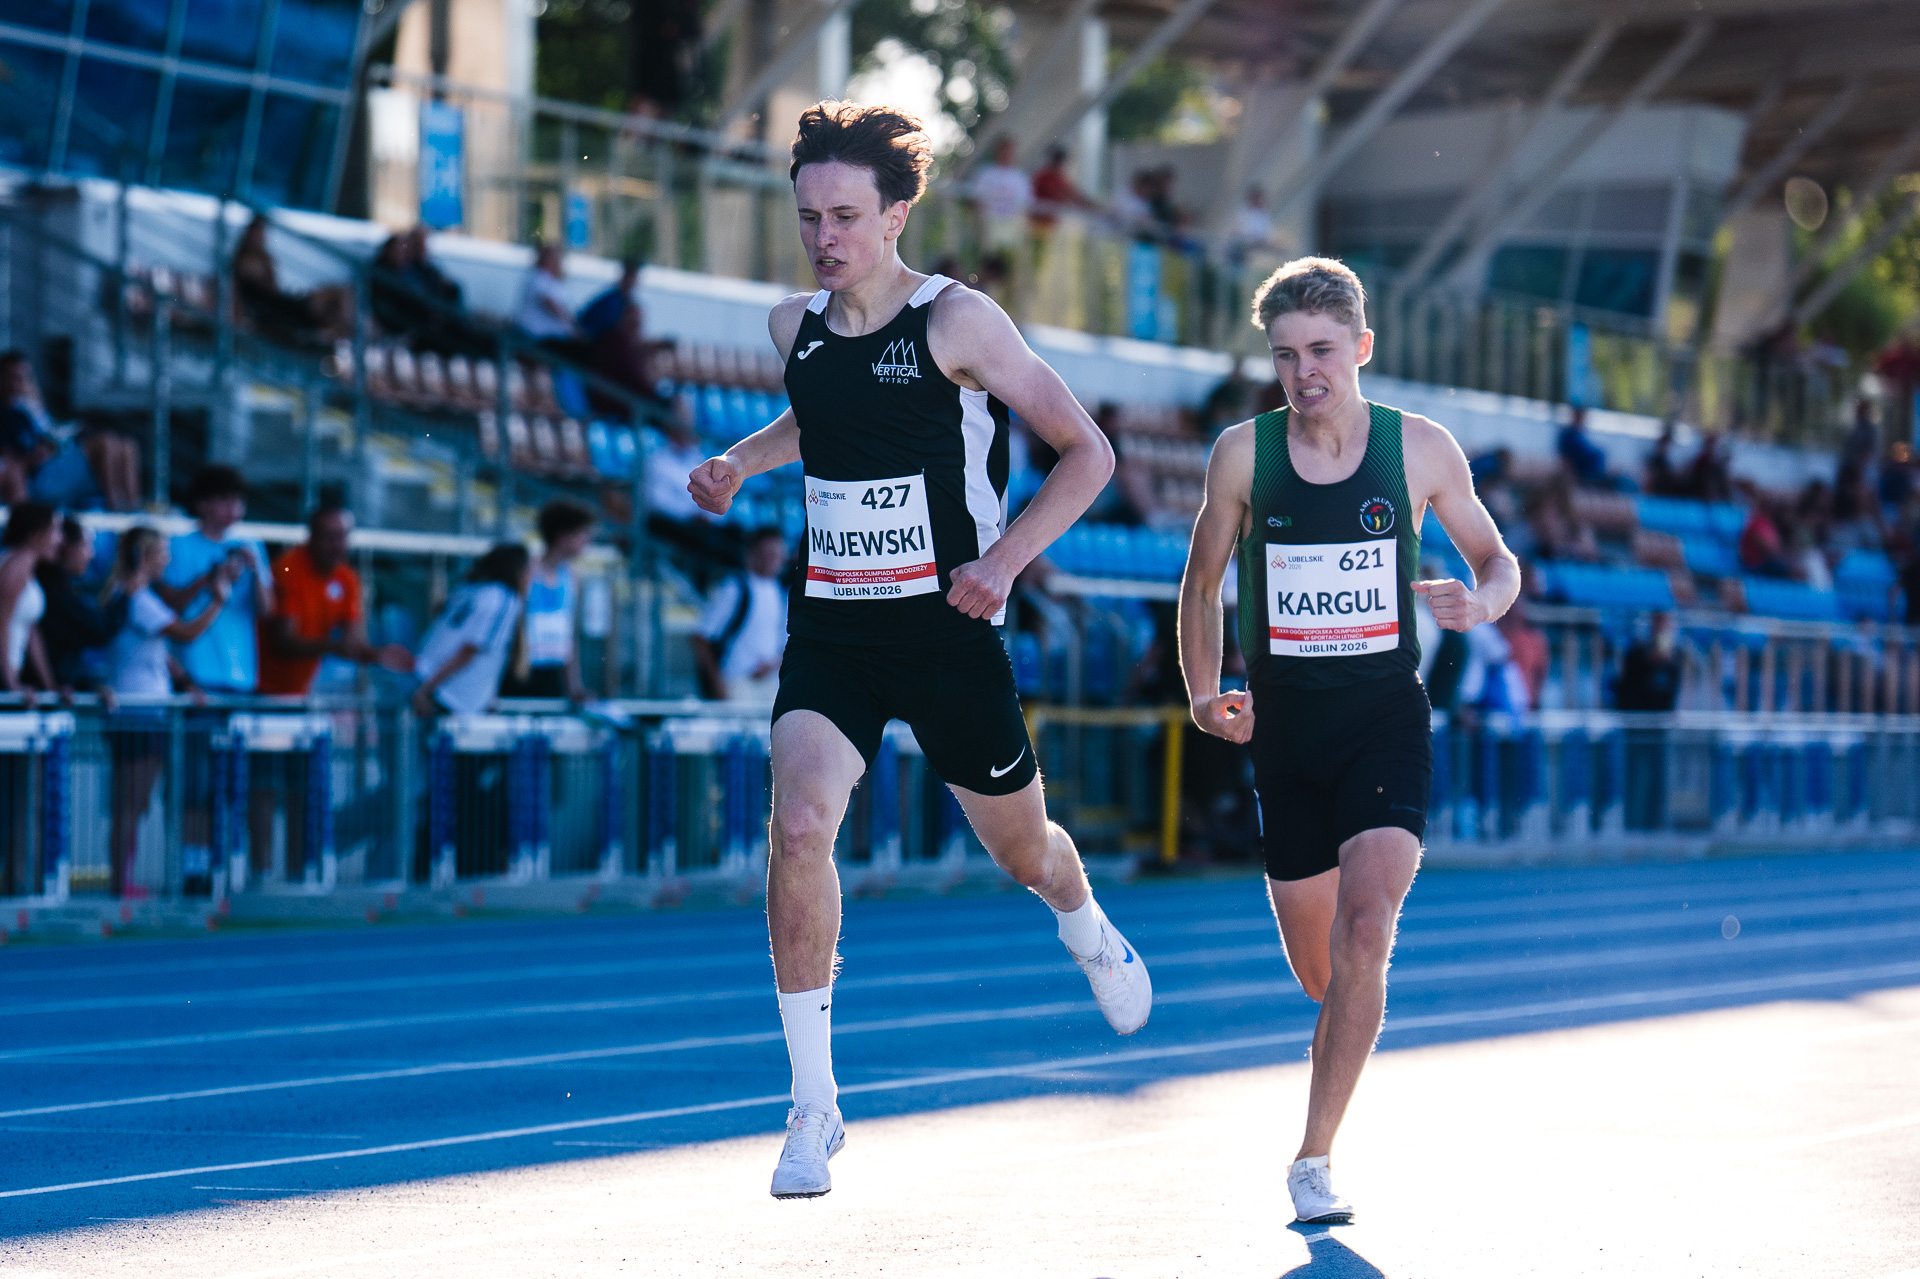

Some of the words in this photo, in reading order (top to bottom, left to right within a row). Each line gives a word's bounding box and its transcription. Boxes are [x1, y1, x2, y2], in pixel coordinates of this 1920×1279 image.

[872, 362, 922, 378] VERTICAL
[818, 490, 846, 500] LUBELSKIE
[861, 484, 910, 510] 427
[812, 525, 926, 557] MAJEWSKI
[1288, 555, 1324, 563] LUBELSKIE
[1339, 548, 1384, 571] 621
[864, 569, 894, 577] OLIMPIADA
[834, 586, 870, 596] LUBLIN
[873, 585, 902, 595] 2026
[1278, 588, 1386, 616] KARGUL
[1300, 644, 1338, 652] LUBLIN
[1341, 642, 1368, 651] 2026
